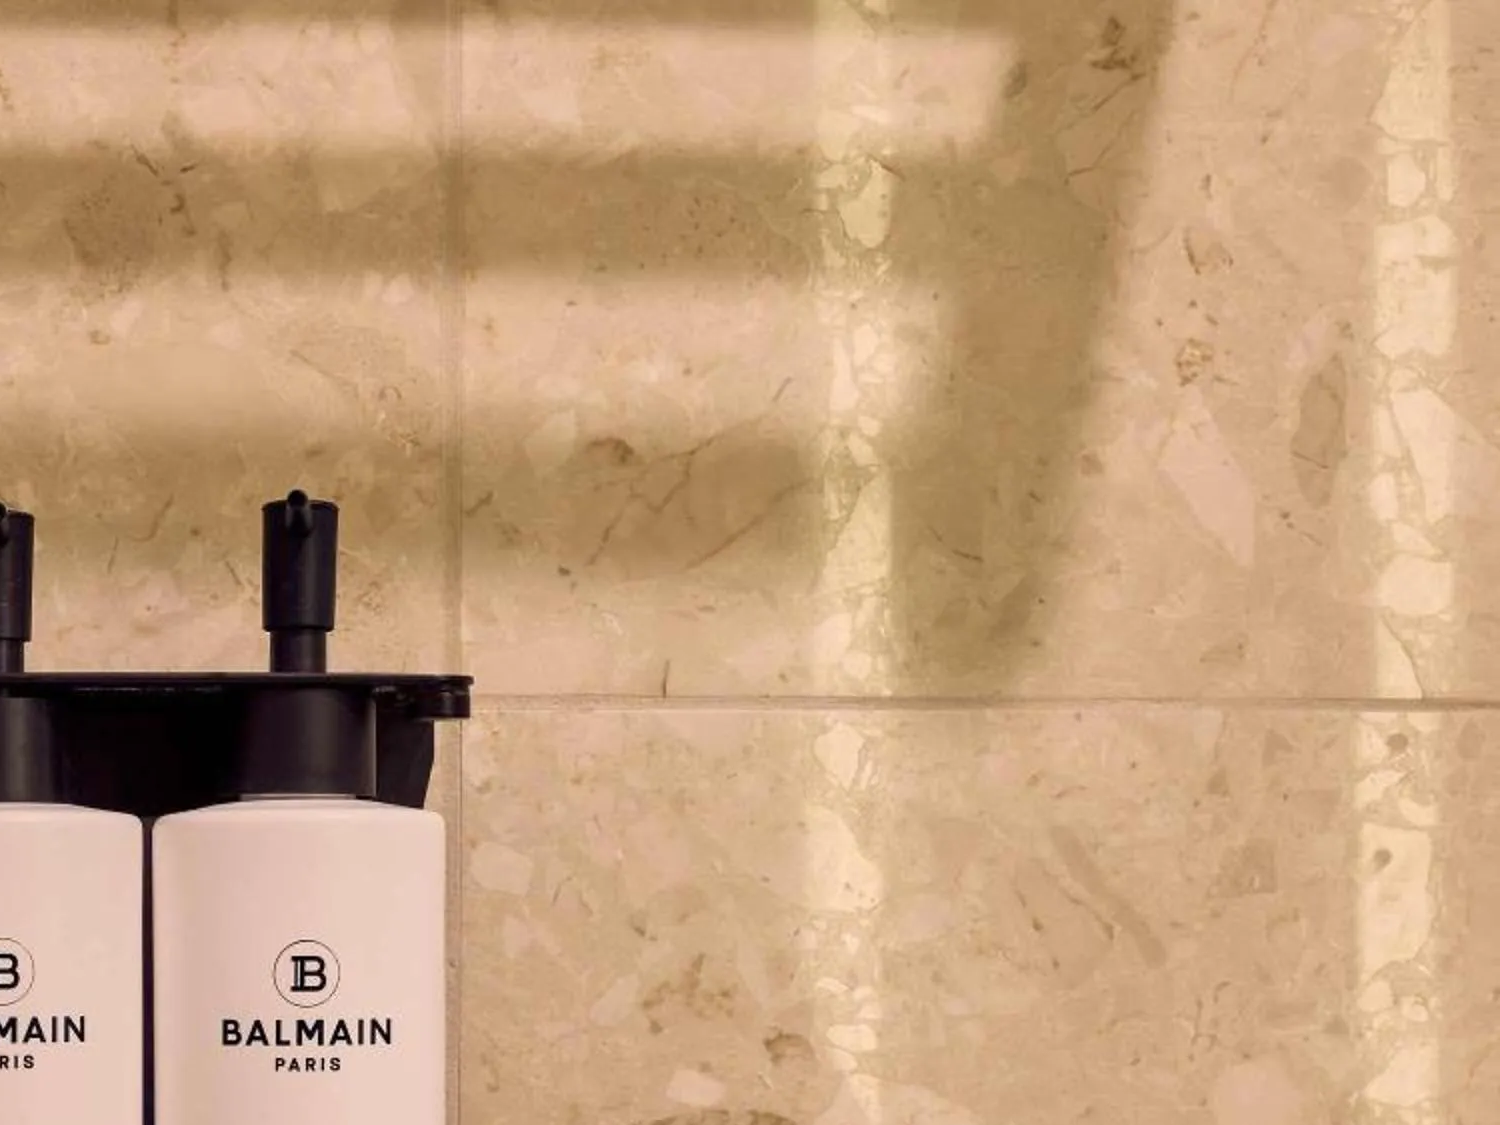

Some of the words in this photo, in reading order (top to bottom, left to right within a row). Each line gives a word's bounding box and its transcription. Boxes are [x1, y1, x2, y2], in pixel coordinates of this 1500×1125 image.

[291, 956, 327, 993] B
[221, 1017, 393, 1047] BALMAIN
[274, 1056, 341, 1073] PARIS
